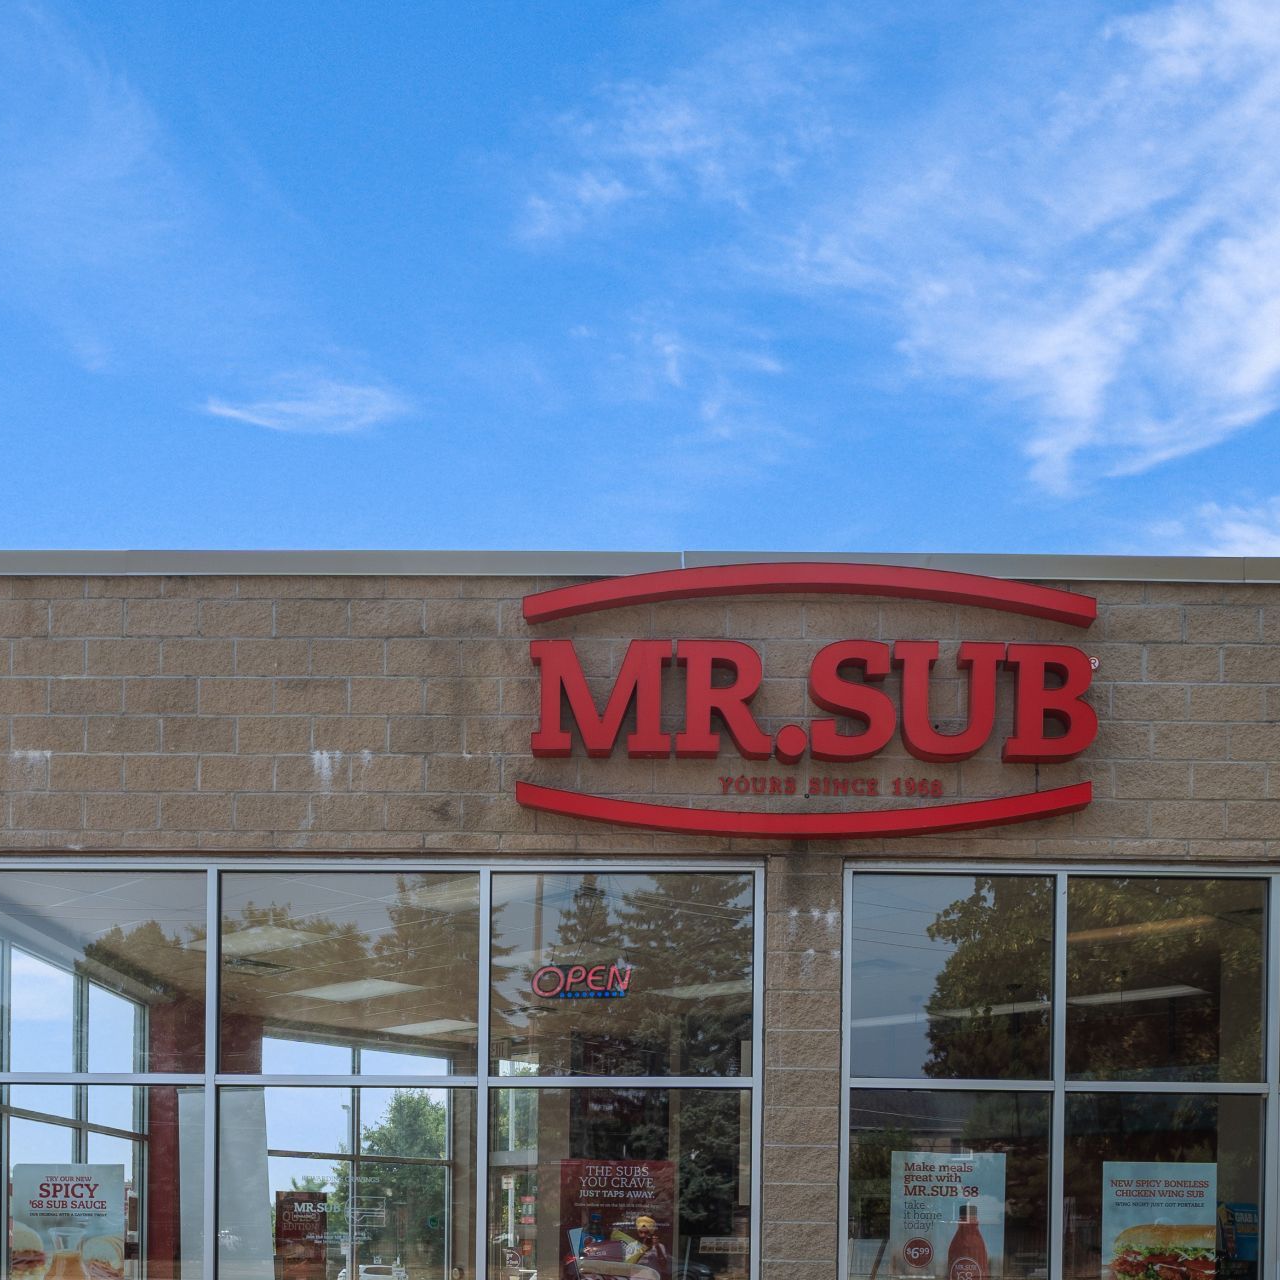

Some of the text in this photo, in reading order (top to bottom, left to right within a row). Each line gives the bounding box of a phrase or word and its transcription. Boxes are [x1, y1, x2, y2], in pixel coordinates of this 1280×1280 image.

[529, 639, 1098, 765] MR.SUB
[719, 776, 945, 797] YOURS SINCE 1968
[532, 964, 632, 998] OPEN
[586, 1166, 649, 1176] THE SUBS
[904, 1162, 973, 1172] Make meals
[579, 1177, 657, 1190] YOU CRAVE,
[904, 1173, 962, 1184] great with
[1110, 1180, 1209, 1188] NEW SPICY BONELESS
[39, 1183, 99, 1198] SPICY
[579, 1190, 655, 1199] JUST TAPS AWAY.
[903, 1185, 959, 1197] MR.SUB
[1115, 1189, 1205, 1198] CHICKEN WING SUB
[46, 1200, 68, 1209] SUB
[70, 1200, 107, 1209] SAUCE
[293, 1202, 341, 1213] MR.SUB
[904, 1201, 926, 1210] take
[904, 1211, 943, 1220] it home
[904, 1221, 934, 1232] today!
